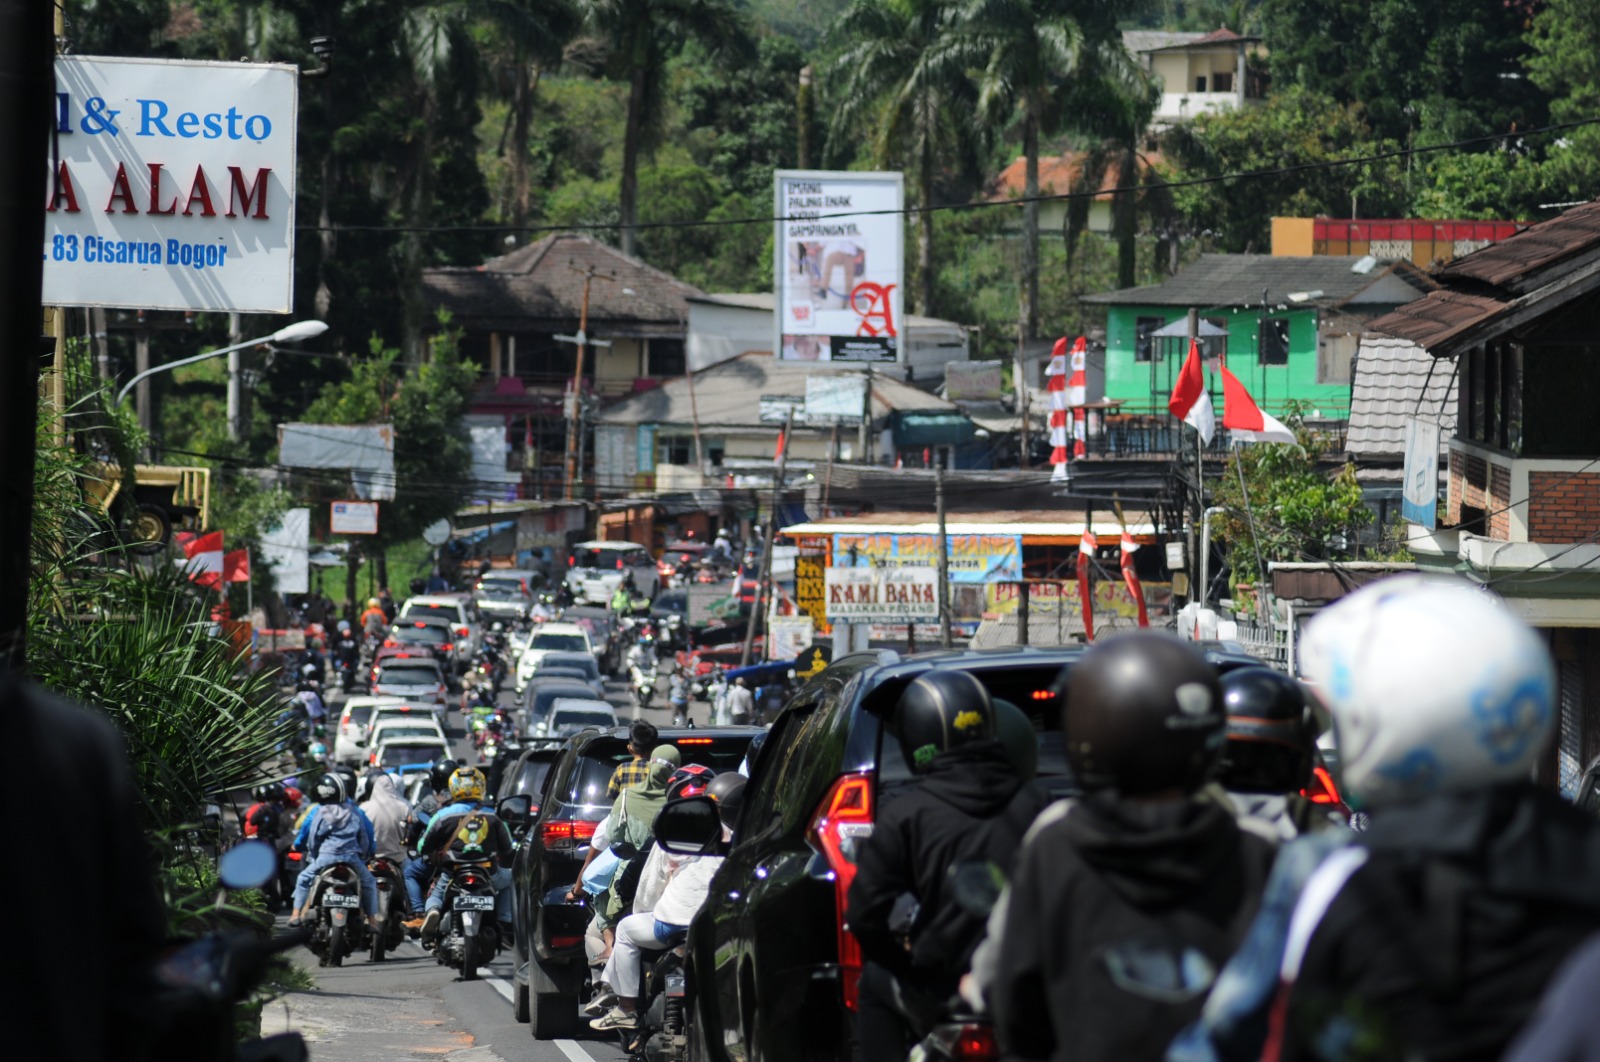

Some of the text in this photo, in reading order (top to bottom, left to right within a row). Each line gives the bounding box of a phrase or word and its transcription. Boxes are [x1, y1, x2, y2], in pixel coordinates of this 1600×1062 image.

[81, 97, 120, 137] &
[136, 99, 272, 140] Resto
[105, 161, 272, 219] ALAM
[53, 234, 227, 269] 83 Cisarua Bogor
[829, 583, 935, 603] KAMI BANA
[830, 604, 934, 613] MASAKAN PADANG
[669, 978, 675, 988] F
